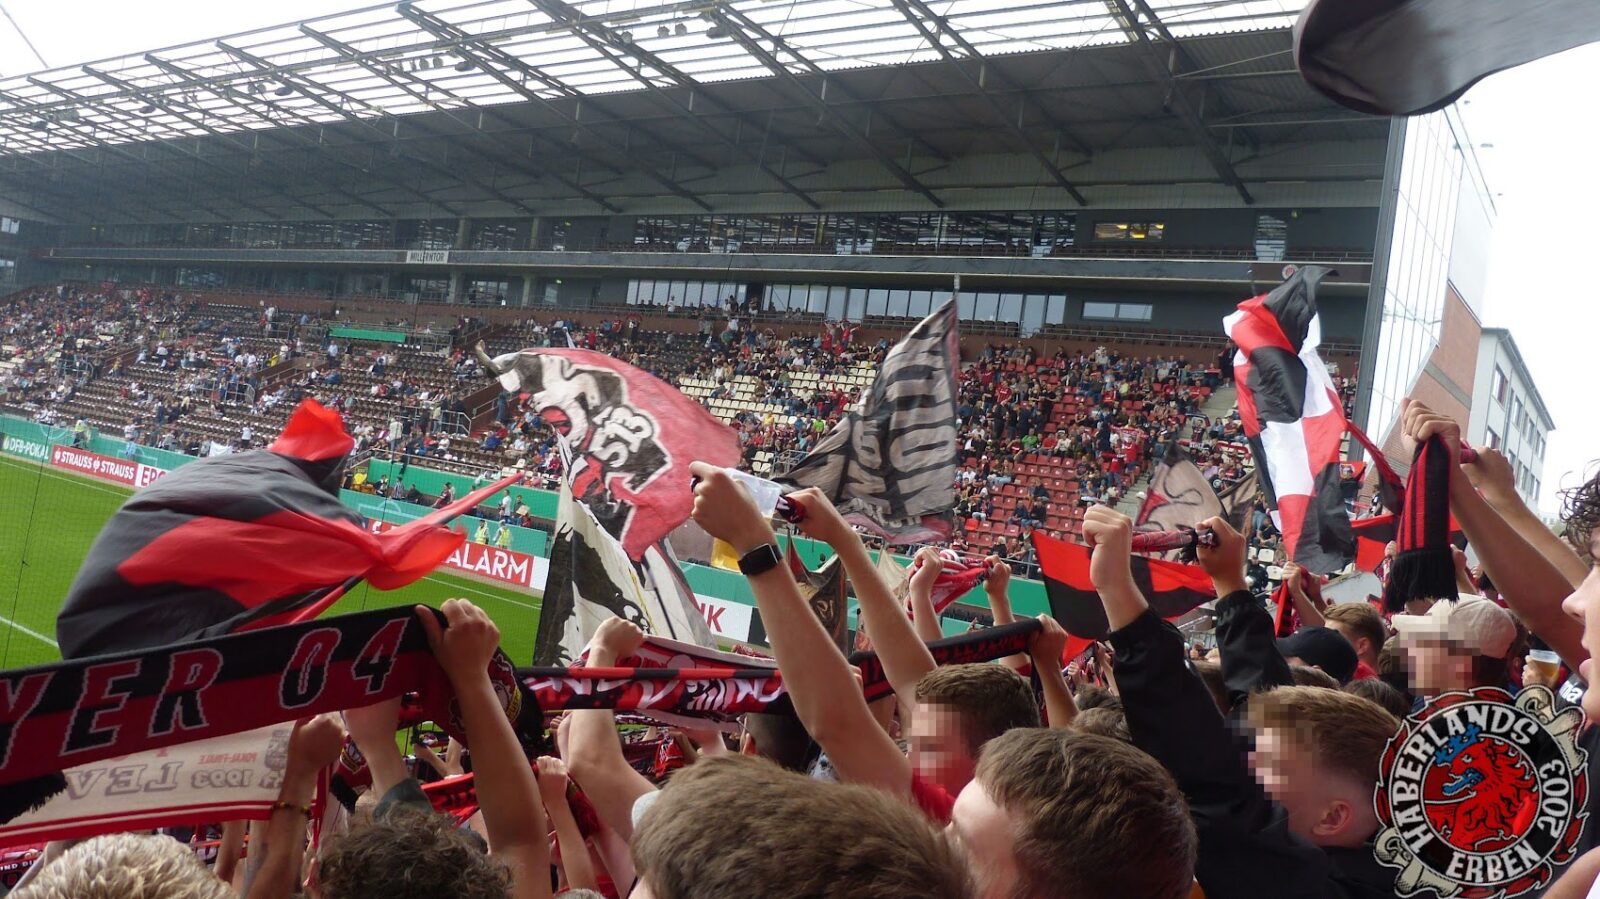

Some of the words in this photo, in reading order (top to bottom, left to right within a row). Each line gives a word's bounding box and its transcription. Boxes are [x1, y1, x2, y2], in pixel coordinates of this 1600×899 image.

[10, 438, 49, 460] DFB-POKAL
[61, 451, 93, 469] STRAUSS
[100, 461, 135, 480] STRAUSS
[446, 543, 530, 584] ALARM
[279, 617, 412, 709] 04
